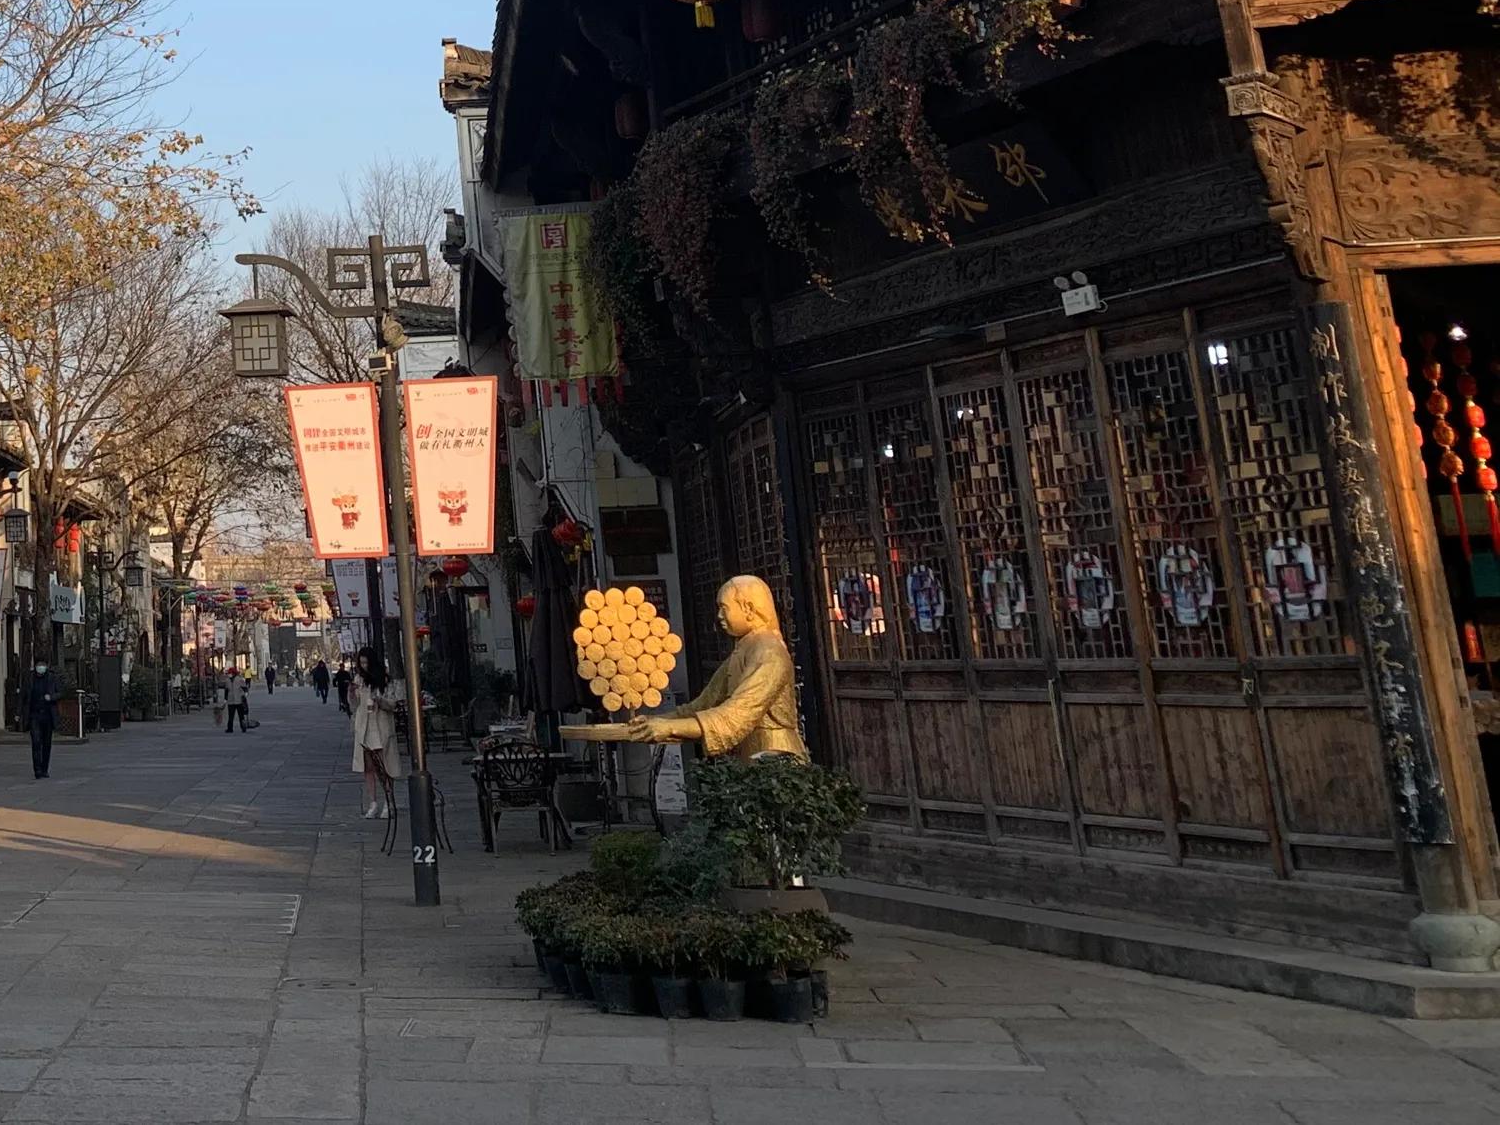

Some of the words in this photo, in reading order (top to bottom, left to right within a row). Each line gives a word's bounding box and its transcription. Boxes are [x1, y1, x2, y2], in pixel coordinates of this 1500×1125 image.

[419, 438, 486, 451] 做有礼衢州人
[413, 845, 436, 863] 22
